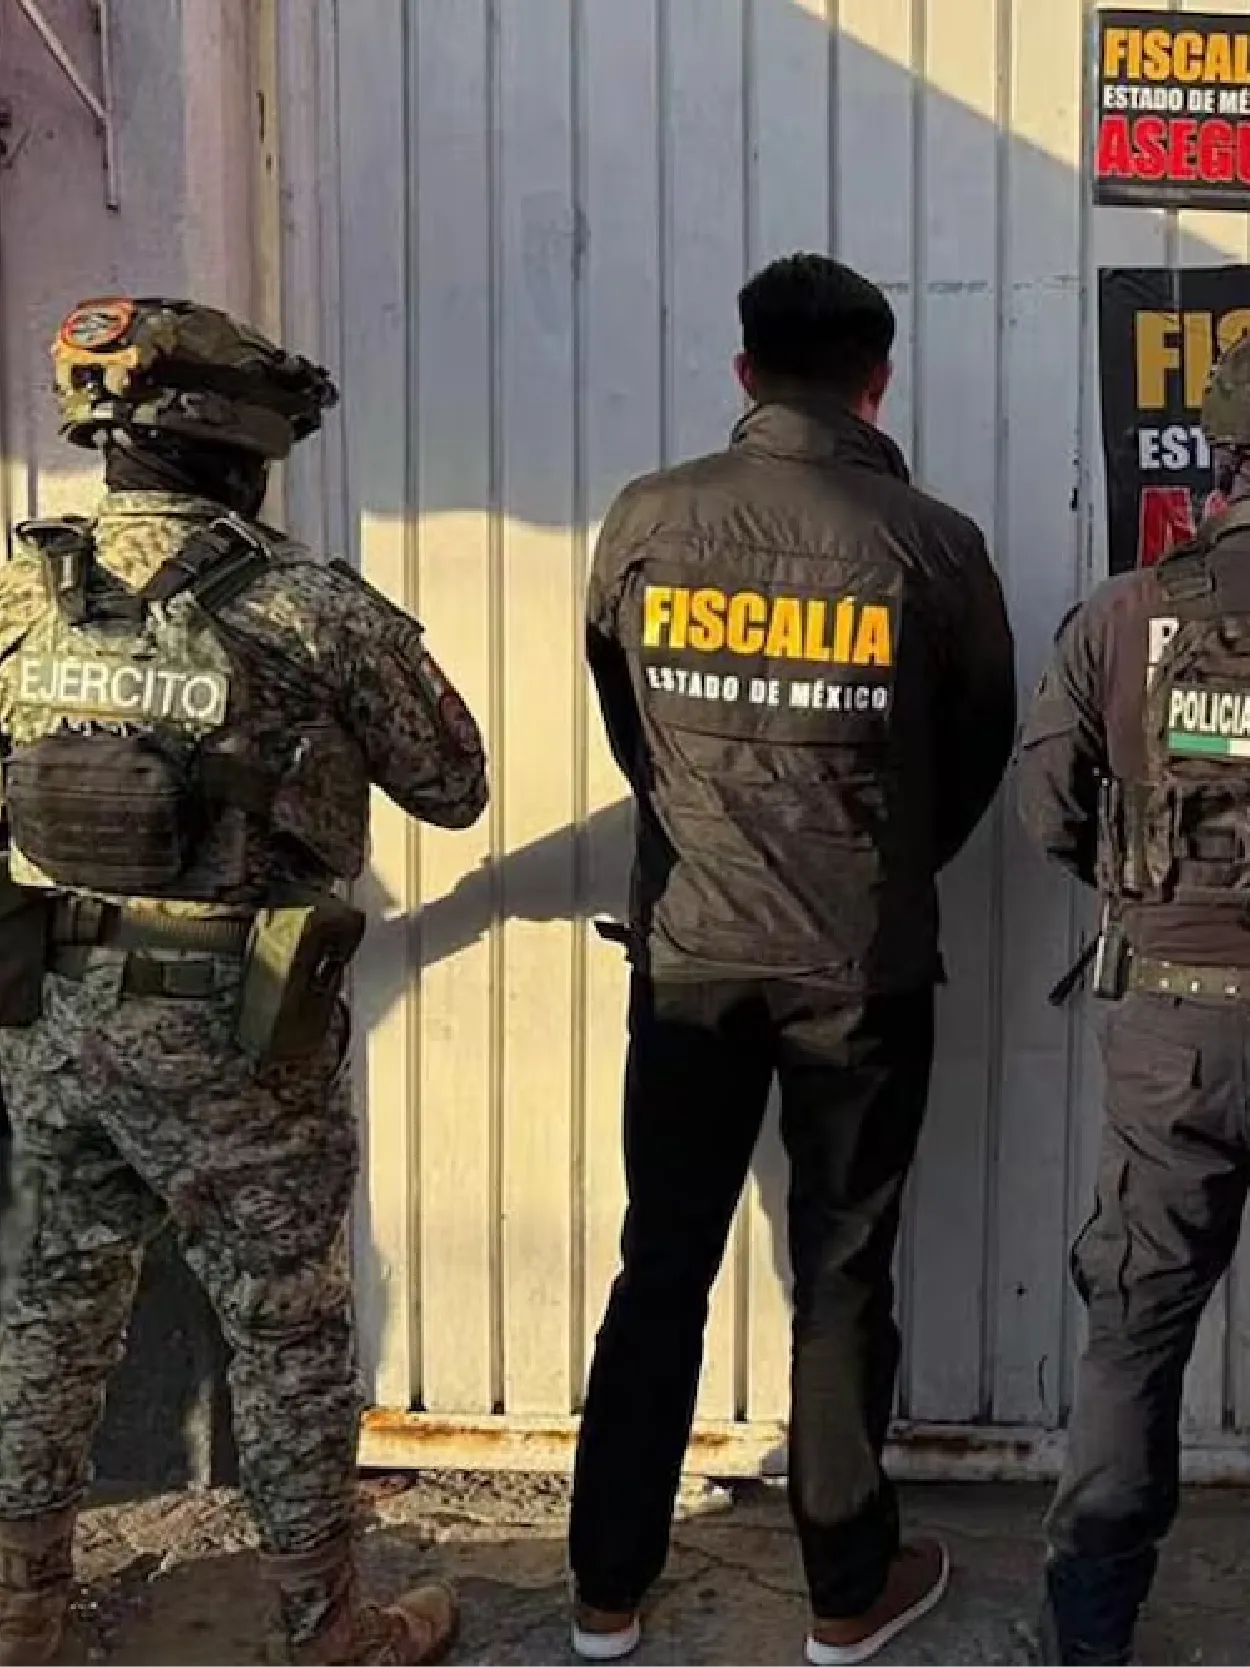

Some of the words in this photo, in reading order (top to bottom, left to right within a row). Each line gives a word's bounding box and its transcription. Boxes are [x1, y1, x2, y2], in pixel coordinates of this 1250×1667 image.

[1104, 85, 1181, 111] ESTADO
[1187, 89, 1215, 113] DE
[643, 585, 892, 666] FISCALÍA
[646, 667, 739, 701] ESTADO
[749, 678, 780, 706] DE
[789, 679, 888, 711] MÉXICO
